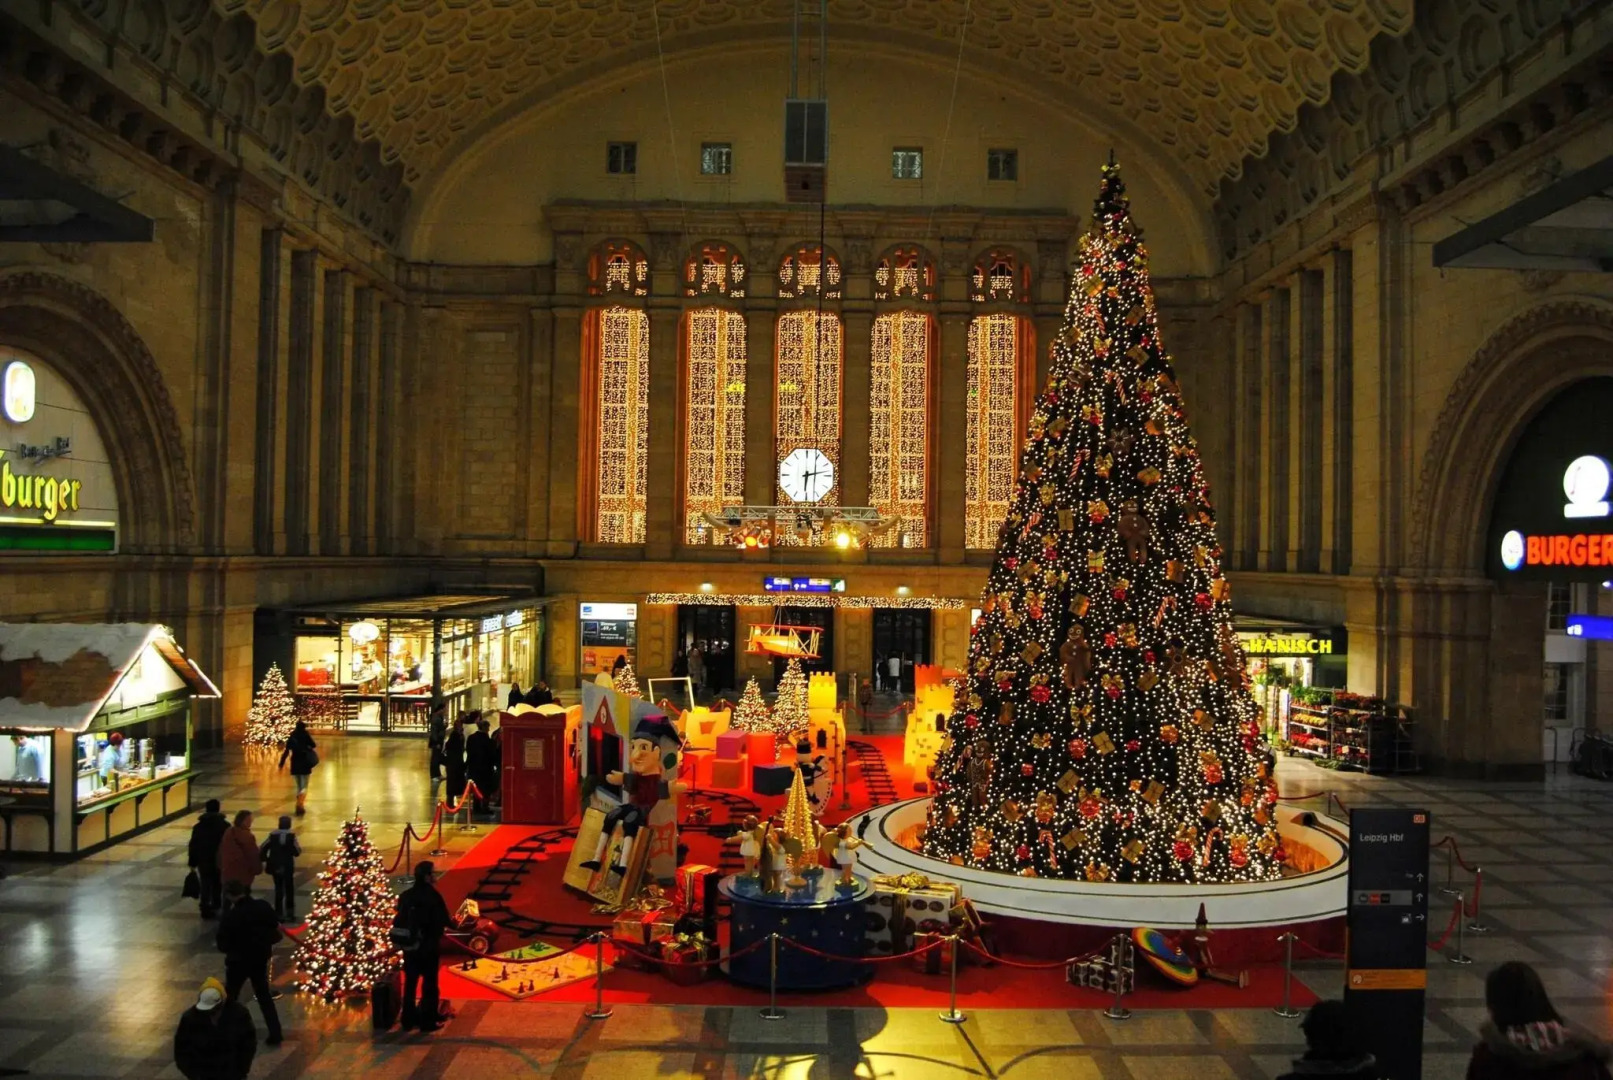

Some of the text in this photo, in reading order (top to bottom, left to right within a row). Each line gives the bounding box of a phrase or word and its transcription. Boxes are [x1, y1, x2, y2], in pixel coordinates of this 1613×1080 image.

[0, 450, 82, 520] burger
[1527, 534, 1613, 566] BURGER
[1359, 833, 1404, 844] Leipzig Hbf
